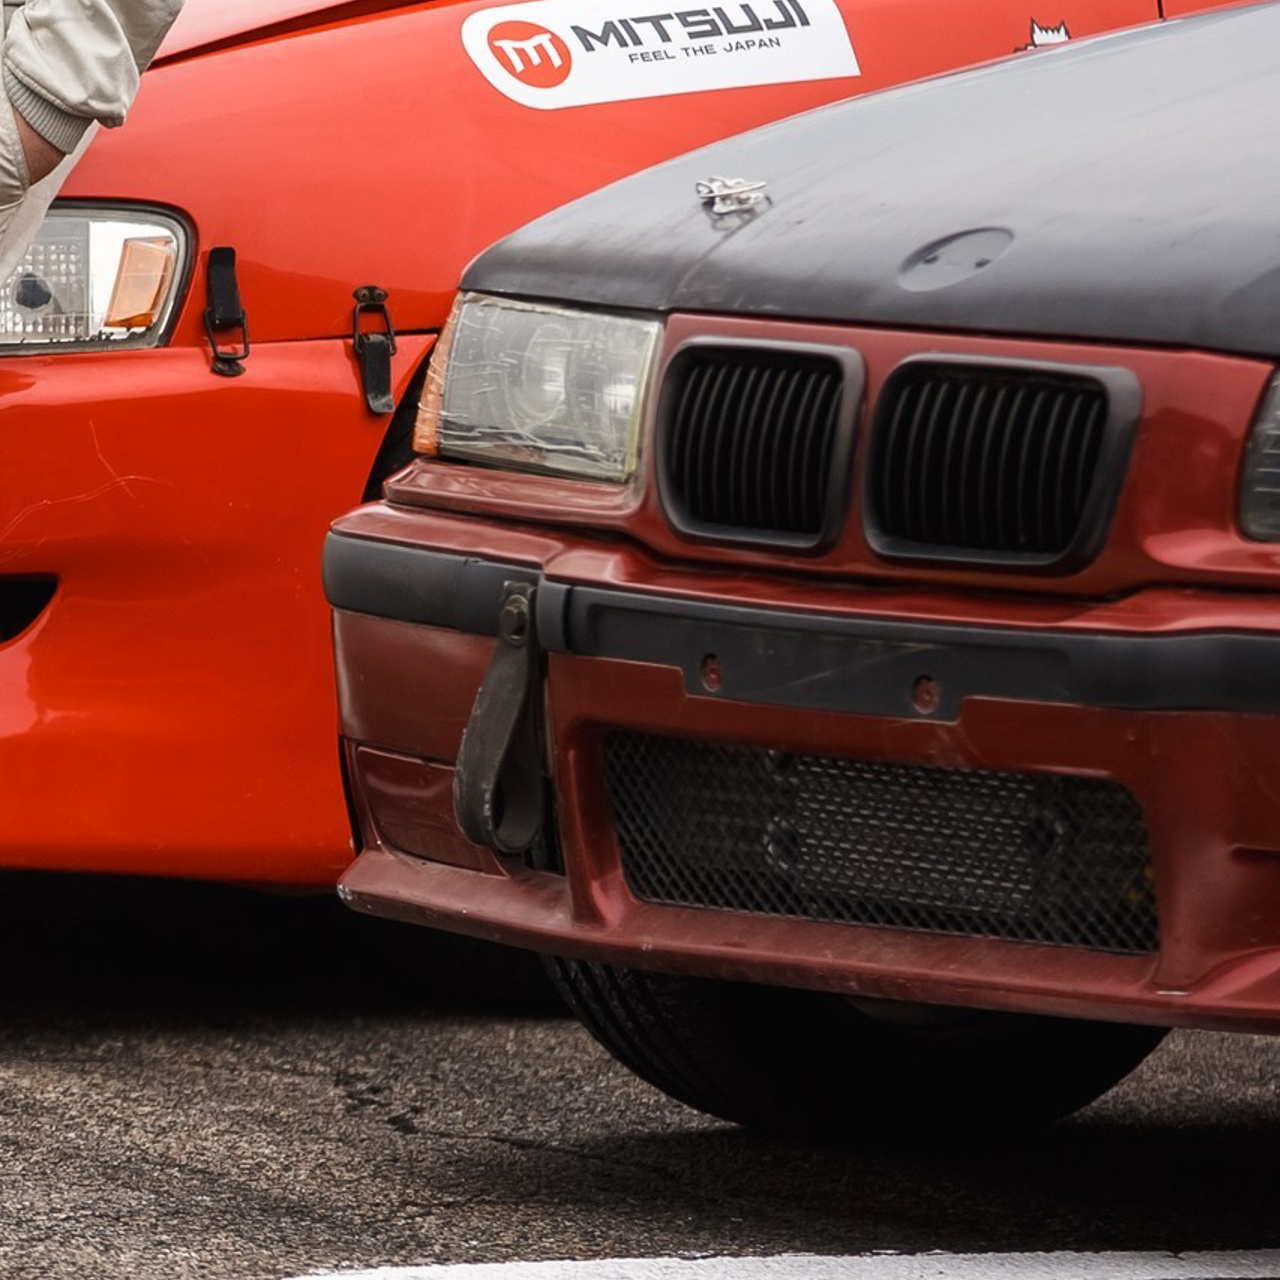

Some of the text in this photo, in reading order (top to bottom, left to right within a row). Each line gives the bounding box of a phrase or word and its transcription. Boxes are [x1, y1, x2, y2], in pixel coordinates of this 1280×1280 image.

[628, 36, 782, 64] FEEL THE JAPAN
